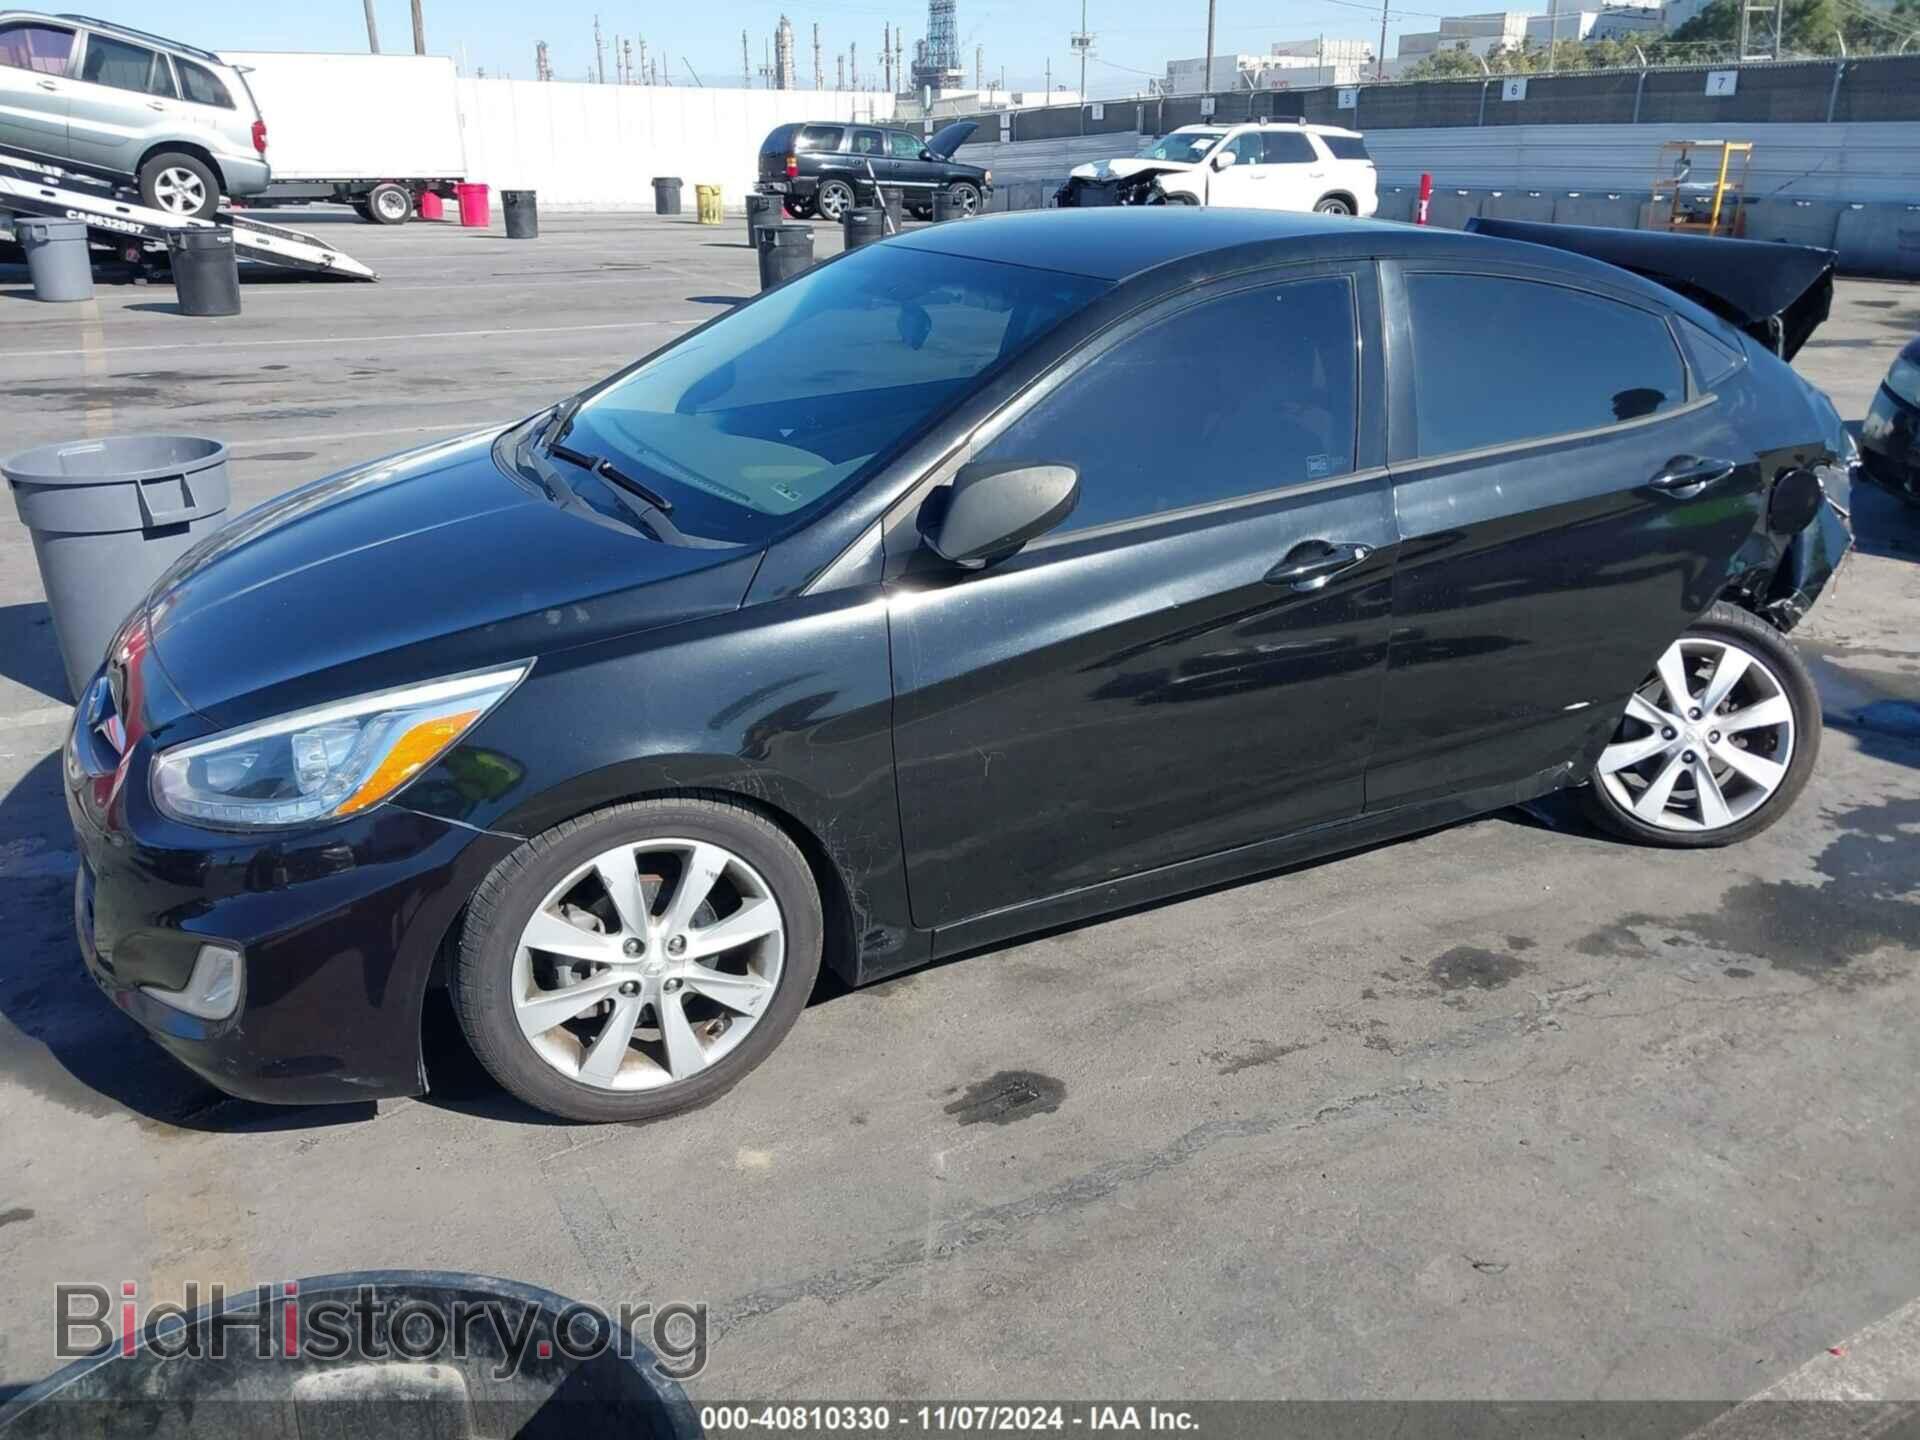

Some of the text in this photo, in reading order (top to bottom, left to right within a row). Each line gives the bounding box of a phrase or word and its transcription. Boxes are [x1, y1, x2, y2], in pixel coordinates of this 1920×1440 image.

[1718, 76, 1727, 89] 7
[1511, 83, 1518, 96] 6
[1344, 93, 1352, 105] 5
